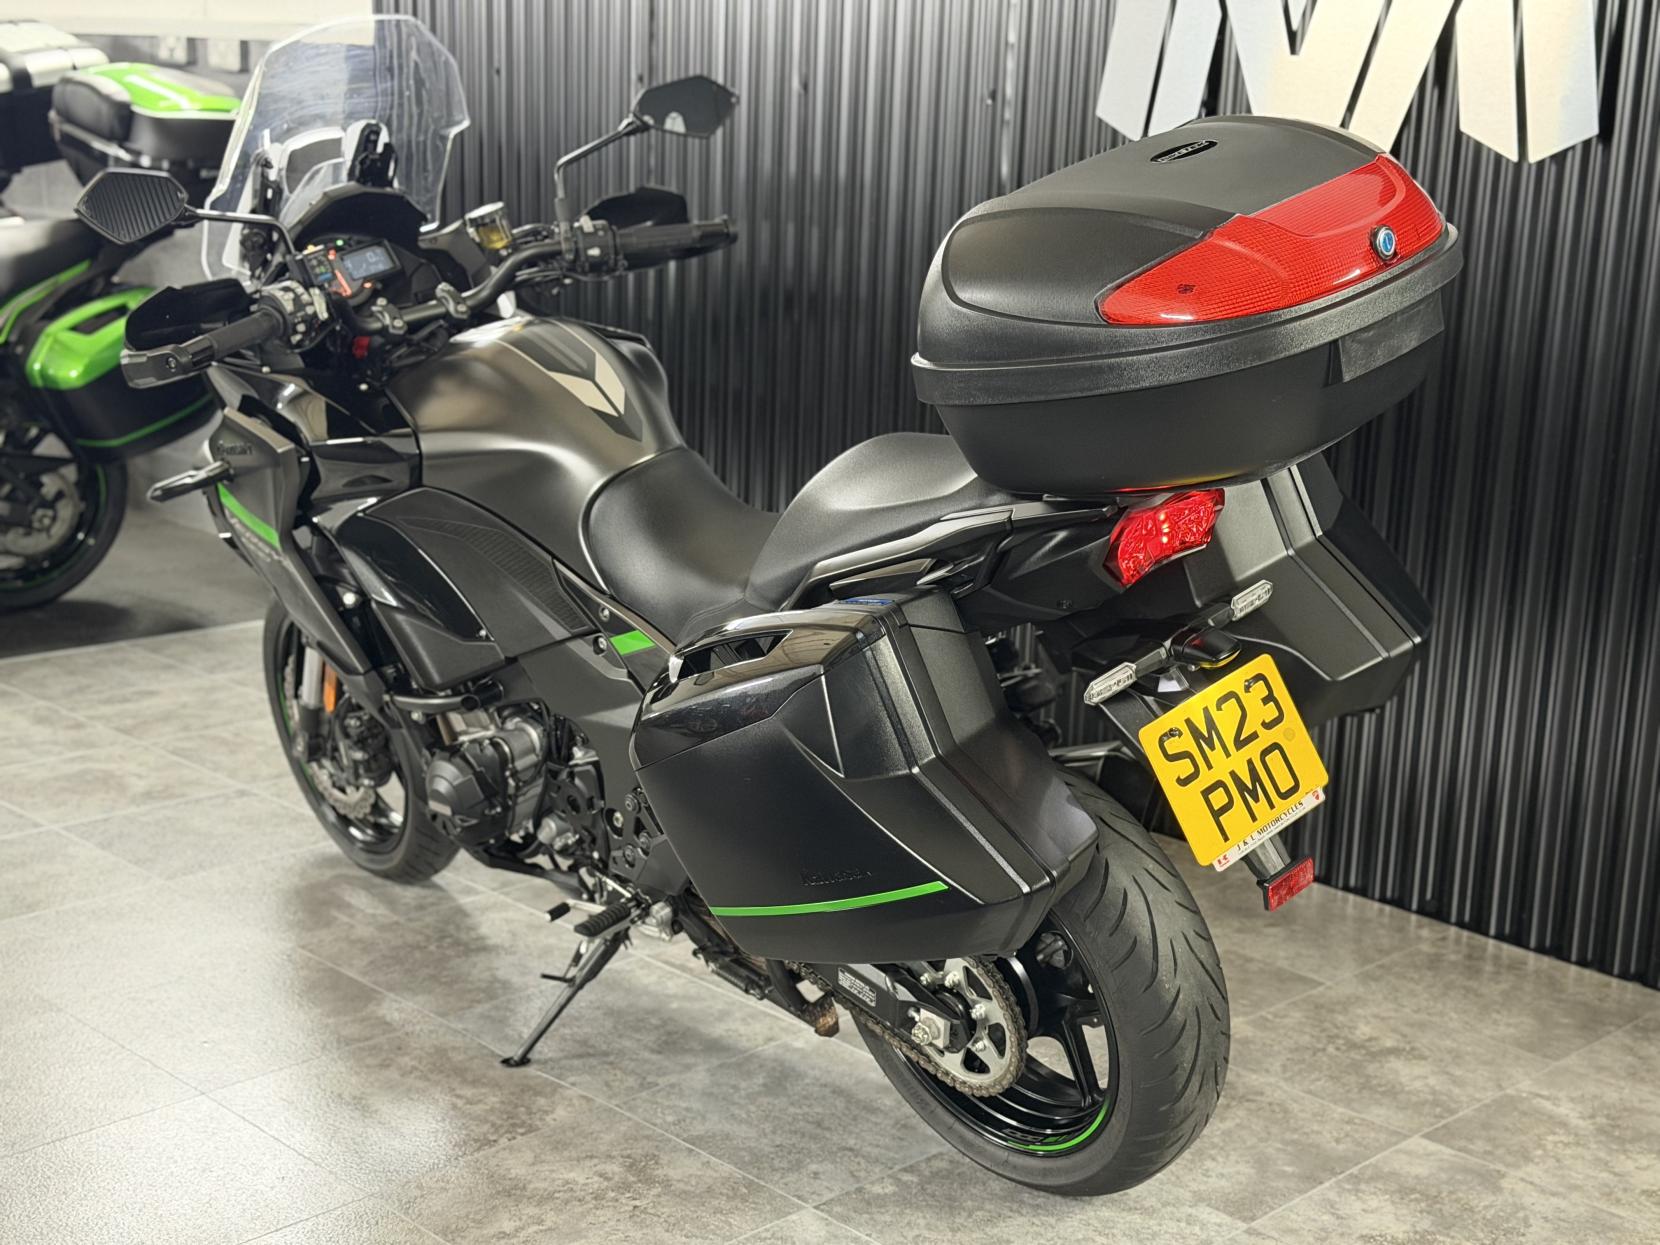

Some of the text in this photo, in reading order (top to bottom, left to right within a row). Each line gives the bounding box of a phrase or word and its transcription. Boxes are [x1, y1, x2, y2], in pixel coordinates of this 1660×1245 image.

[1158, 673, 1285, 787] SM23
[1200, 742, 1301, 843] PMO
[1256, 800, 1304, 836] MOTORCYCLES
